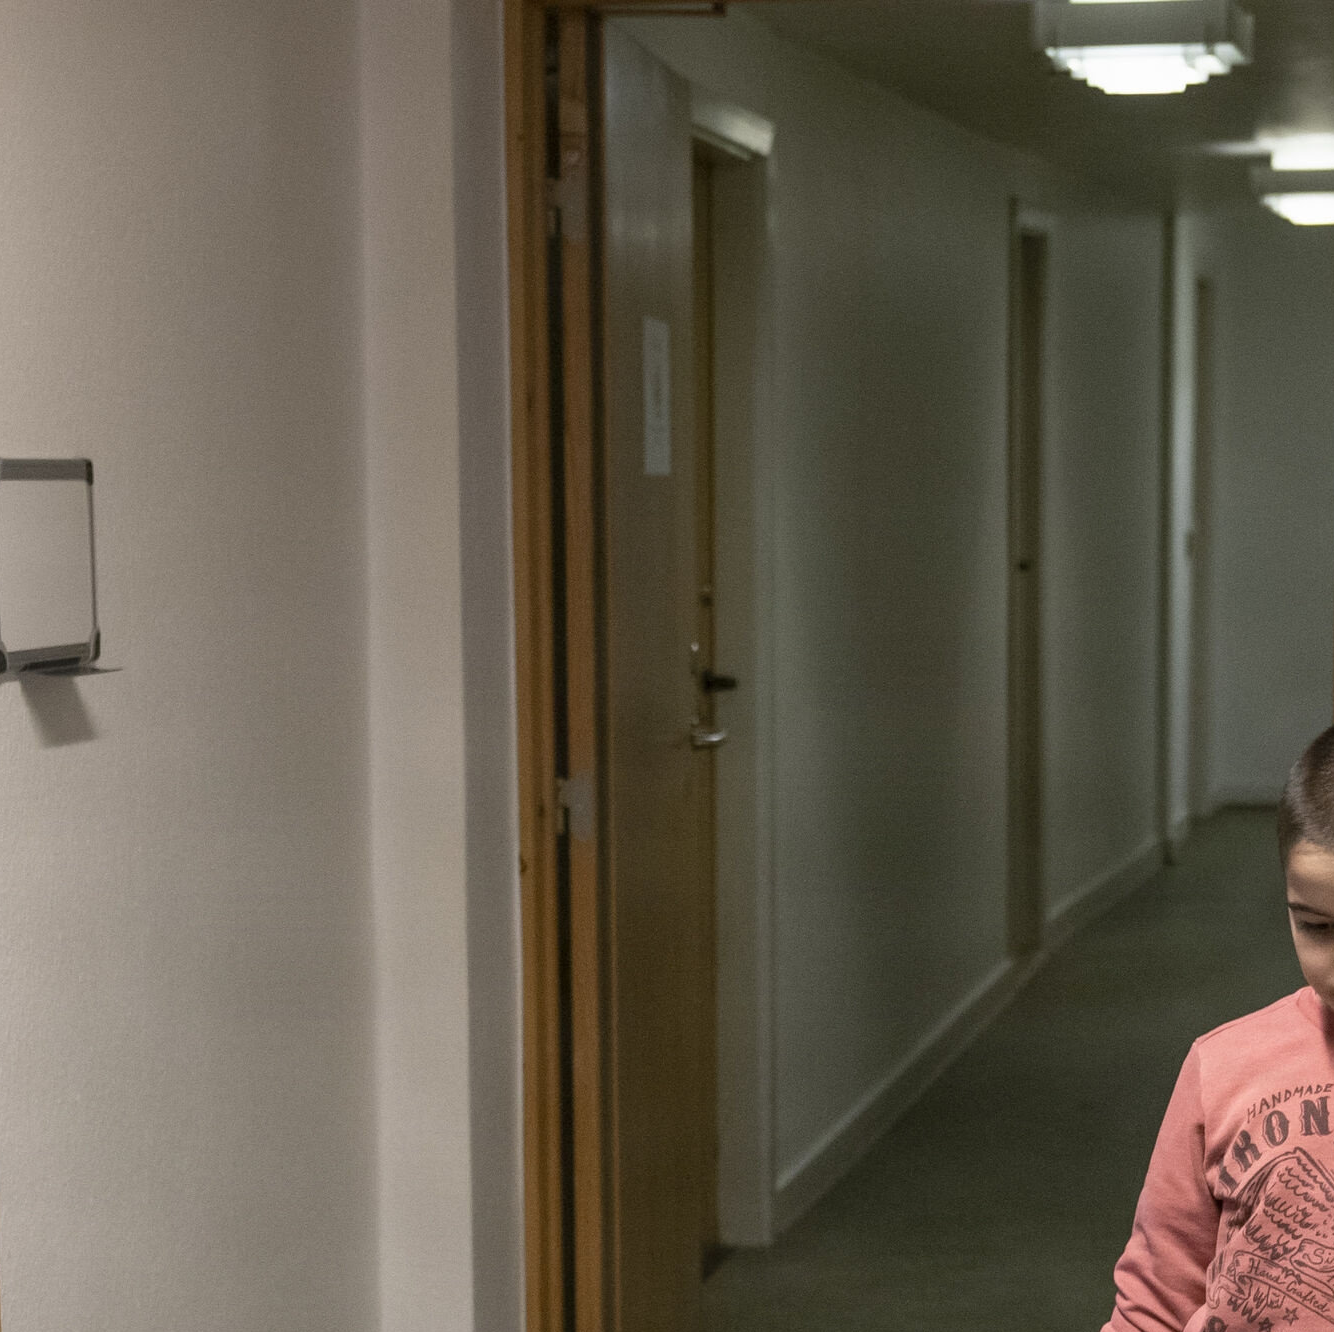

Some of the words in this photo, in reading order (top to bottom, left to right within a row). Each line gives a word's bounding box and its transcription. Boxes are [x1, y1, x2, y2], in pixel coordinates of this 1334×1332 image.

[1247, 1083, 1334, 1123] HANDMADE
[1247, 1257, 1285, 1285] Hand
[1286, 1280, 1330, 1313] Crafted
